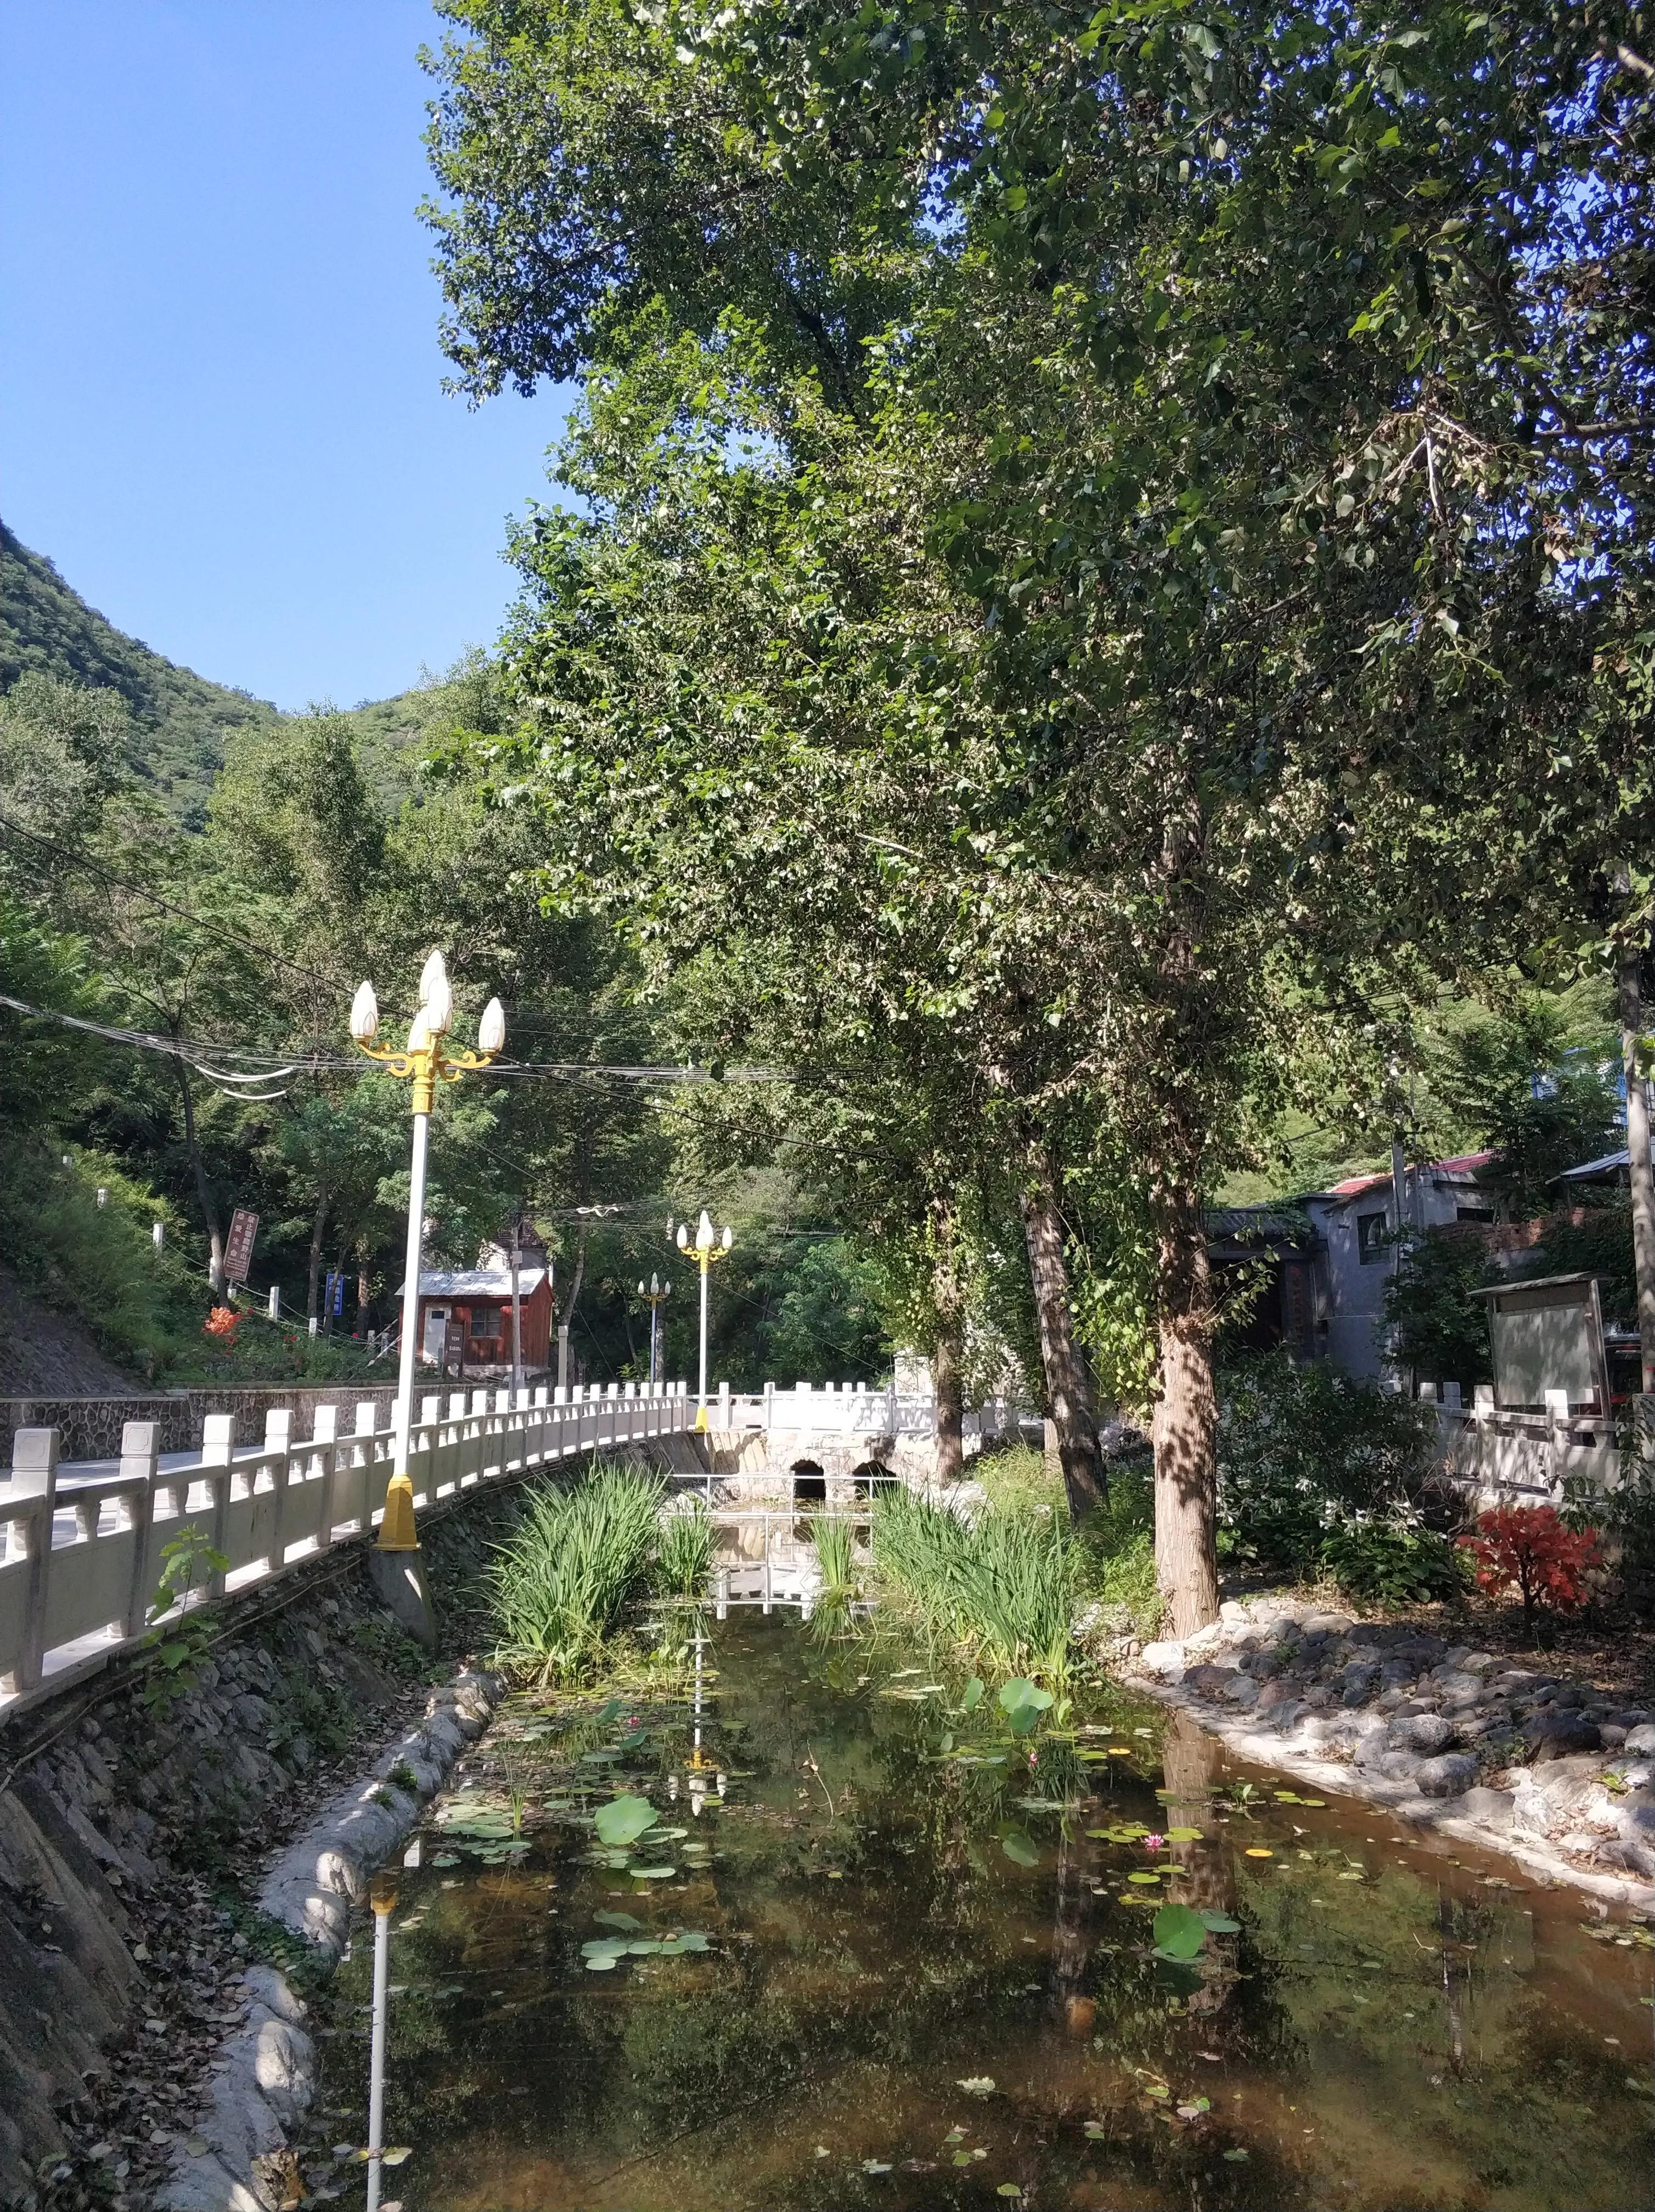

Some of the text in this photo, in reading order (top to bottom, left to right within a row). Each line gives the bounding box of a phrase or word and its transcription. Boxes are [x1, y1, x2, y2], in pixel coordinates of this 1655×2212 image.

[230, 1212, 245, 1257] 珍爱生命
[240, 1215, 255, 1261] 禁止攀爬野山
